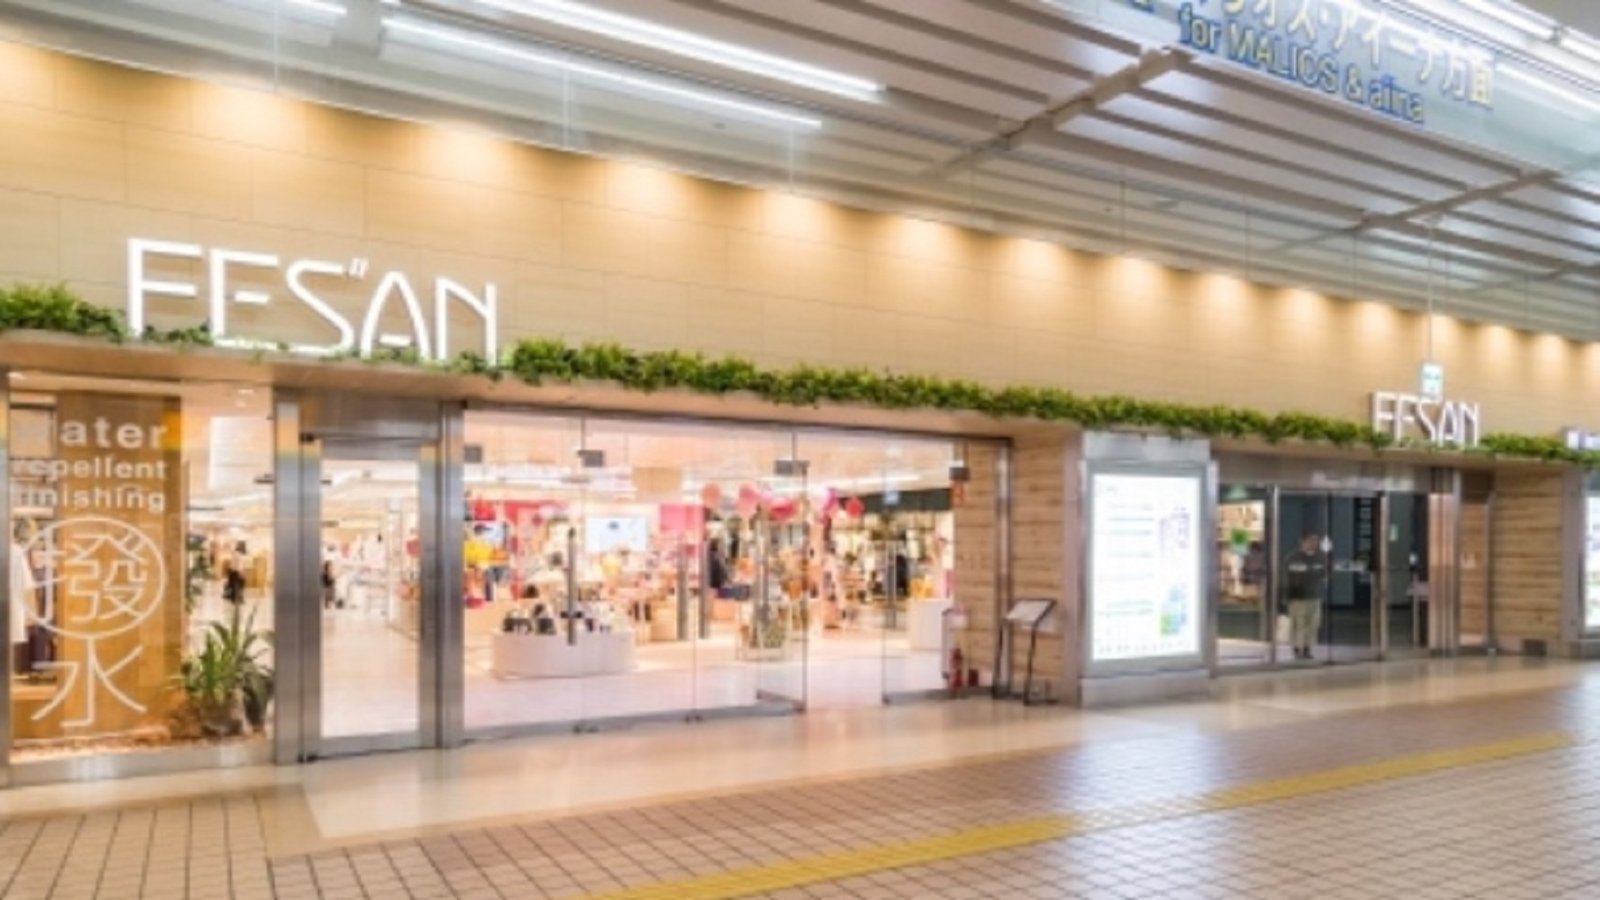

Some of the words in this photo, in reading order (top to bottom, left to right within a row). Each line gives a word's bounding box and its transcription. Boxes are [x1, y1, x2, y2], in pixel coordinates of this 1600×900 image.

[1180, 3, 1221, 53] for
[1344, 62, 1364, 103] &
[50, 416, 167, 449] ater
[11, 456, 166, 482] repellent
